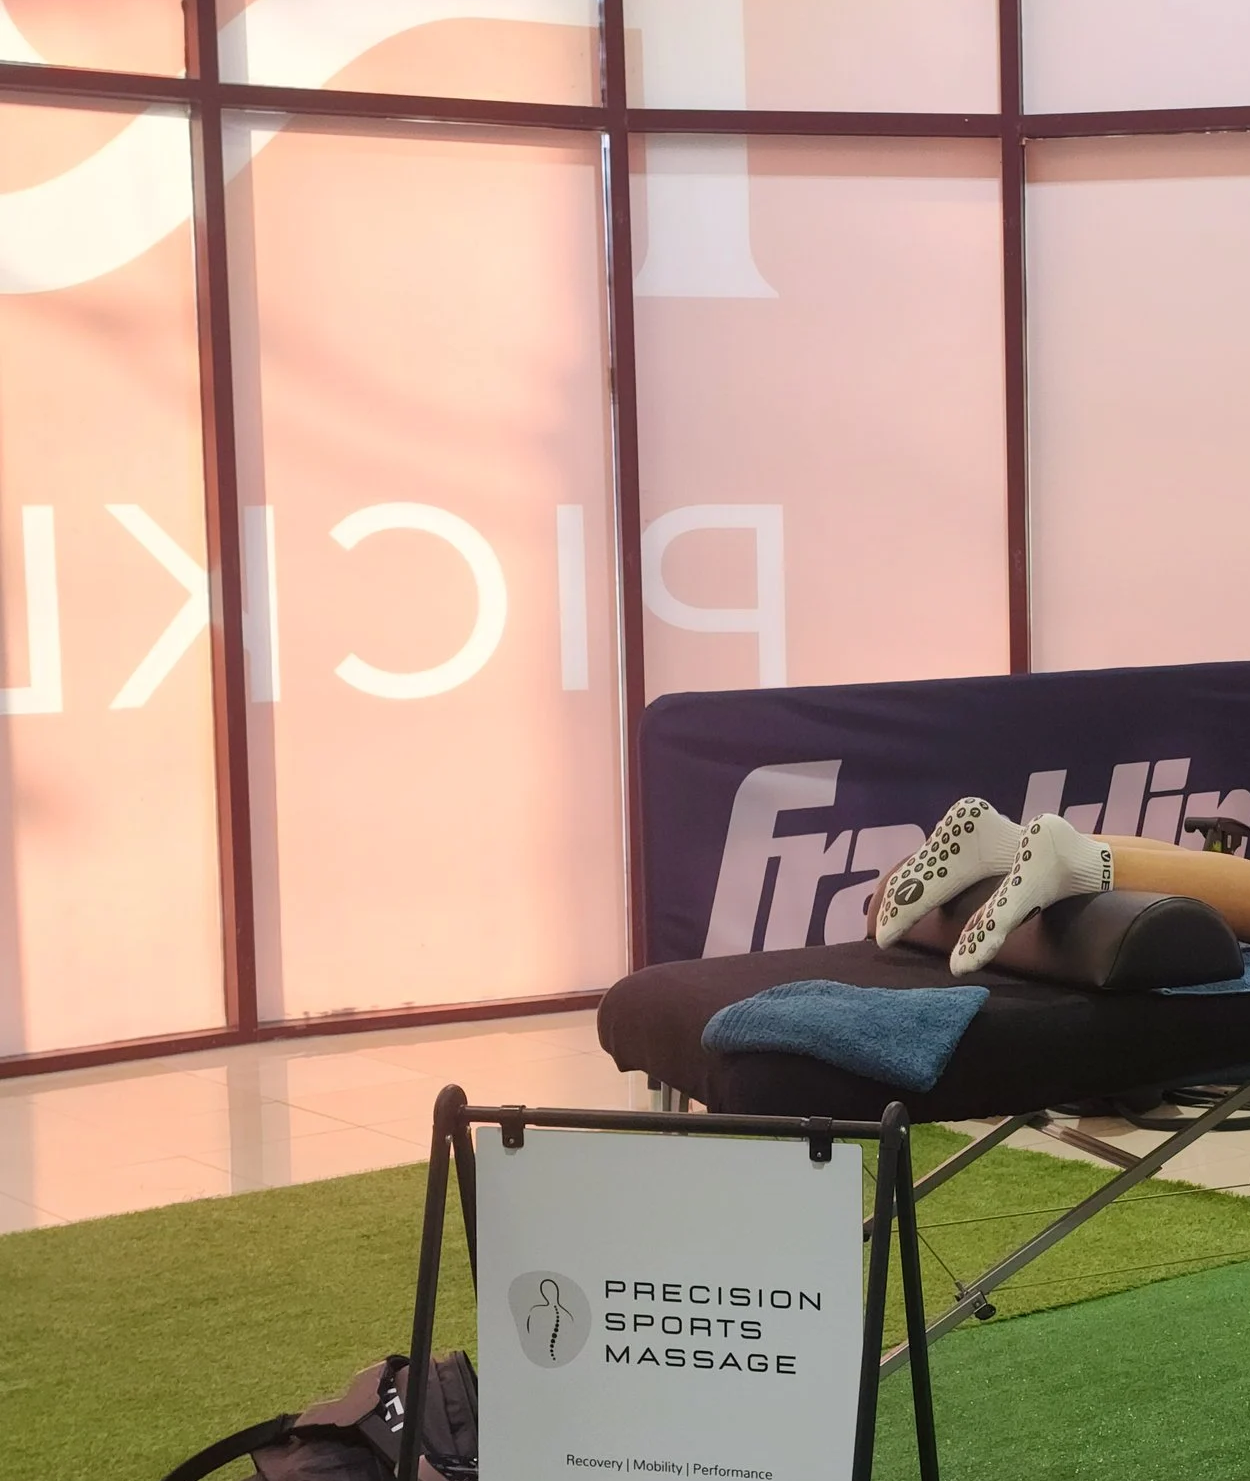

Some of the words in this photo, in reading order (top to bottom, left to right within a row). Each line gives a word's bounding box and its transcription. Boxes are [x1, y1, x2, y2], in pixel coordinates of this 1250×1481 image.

[605, 1280, 821, 1311] PRECISION
[605, 1312, 762, 1340] SPORTS
[605, 1344, 796, 1375] MASSAGE
[566, 1454, 623, 1472] Recovery
[633, 1459, 683, 1477] Mobility
[693, 1463, 773, 1480] Performance
